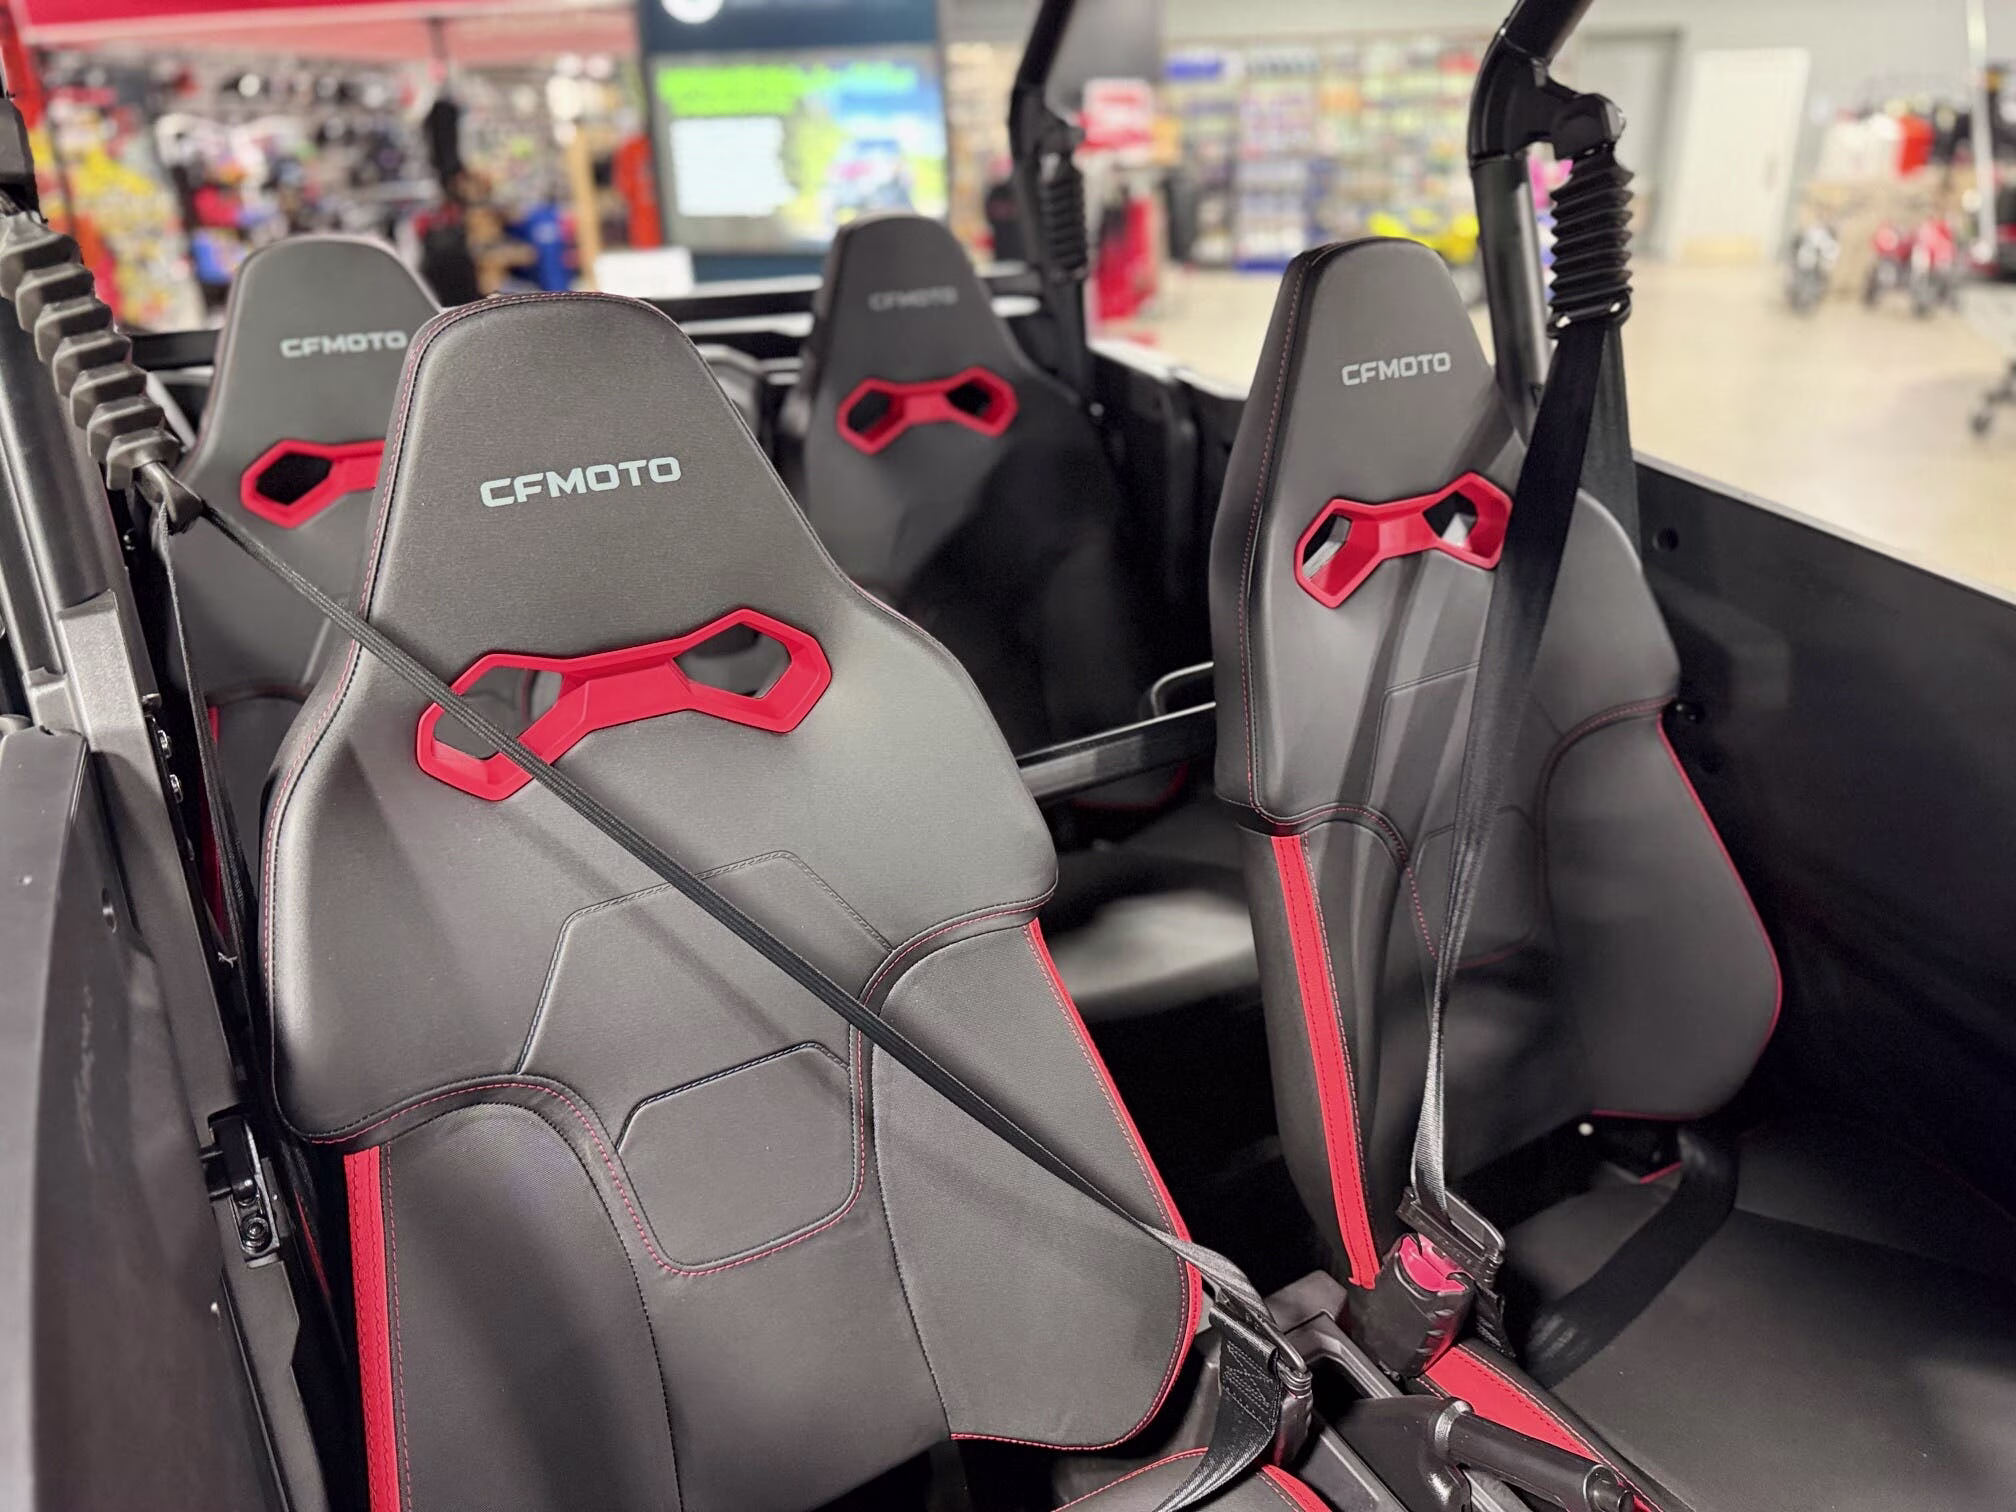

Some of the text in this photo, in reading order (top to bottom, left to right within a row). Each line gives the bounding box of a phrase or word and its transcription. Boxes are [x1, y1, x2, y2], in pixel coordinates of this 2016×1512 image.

[280, 331, 407, 357] CFMOTO
[1342, 352, 1451, 385] CFMOTO
[480, 456, 681, 507] CFMOTO
